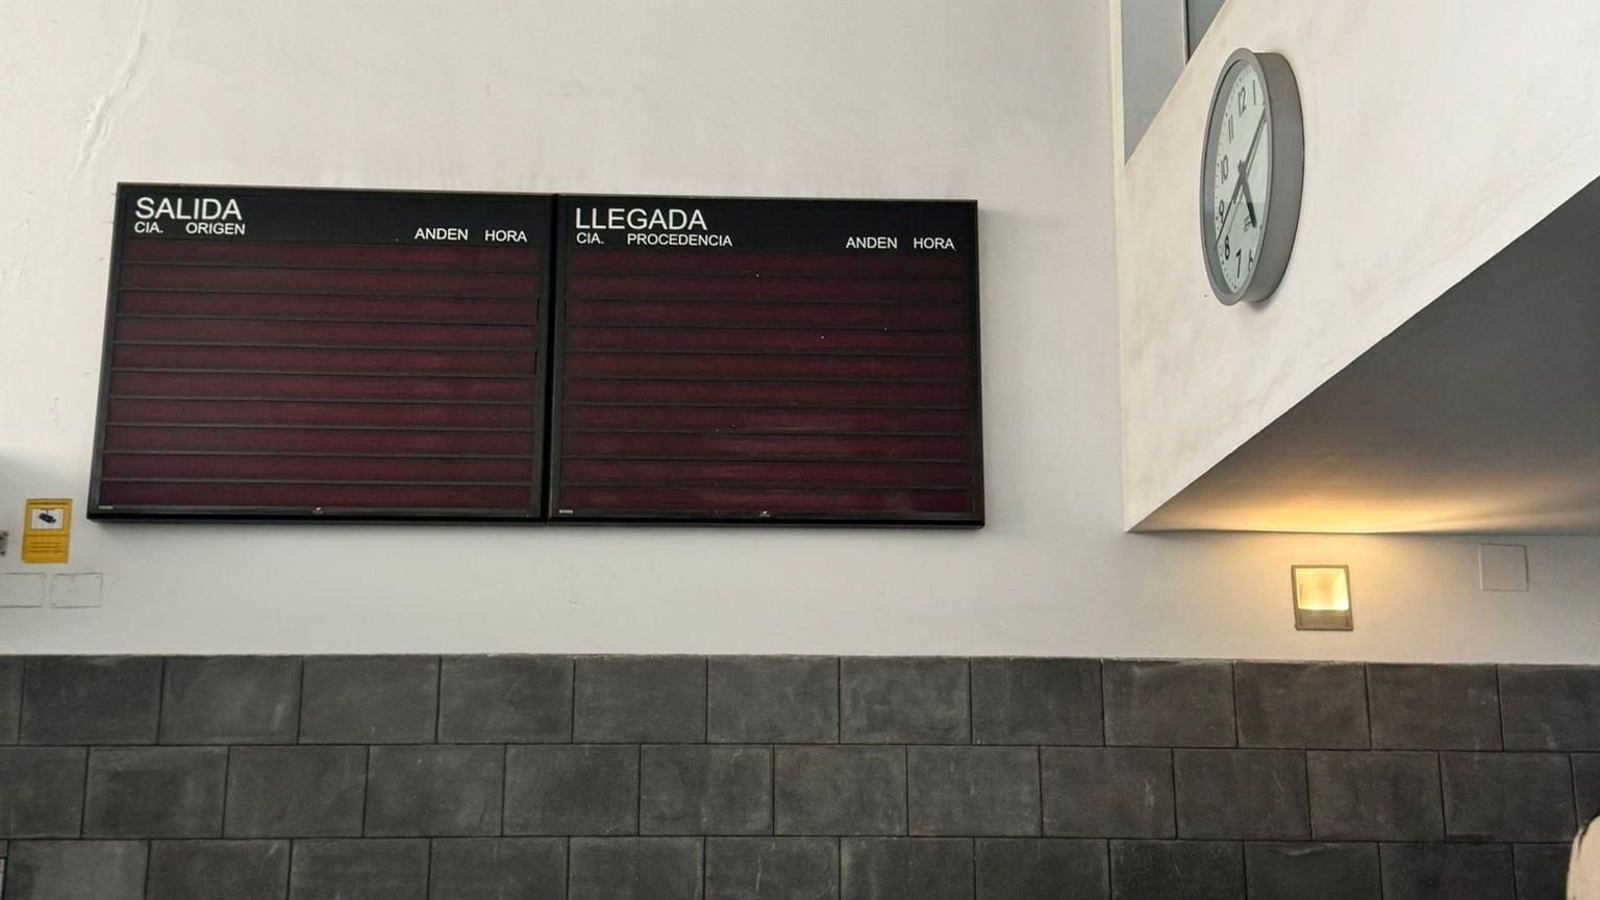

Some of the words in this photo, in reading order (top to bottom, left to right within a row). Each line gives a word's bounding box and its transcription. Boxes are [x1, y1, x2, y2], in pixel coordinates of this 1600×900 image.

[1238, 86, 1247, 118] 12
[1228, 114, 1235, 144] 11
[1221, 155, 1229, 185] 10
[134, 196, 243, 221] SALIDA
[575, 207, 708, 231] LLEGADA
[1219, 199, 1225, 224] 9
[134, 221, 164, 234] CIA.
[185, 222, 246, 236] ORIGEN
[414, 227, 469, 241] ANDEN
[484, 229, 528, 243] HORA
[576, 232, 605, 245] CIA.
[626, 233, 733, 247] PROCEDENCIA
[845, 236, 898, 250] ANDEN
[913, 237, 957, 251] HORA
[1225, 235, 1230, 261] 8
